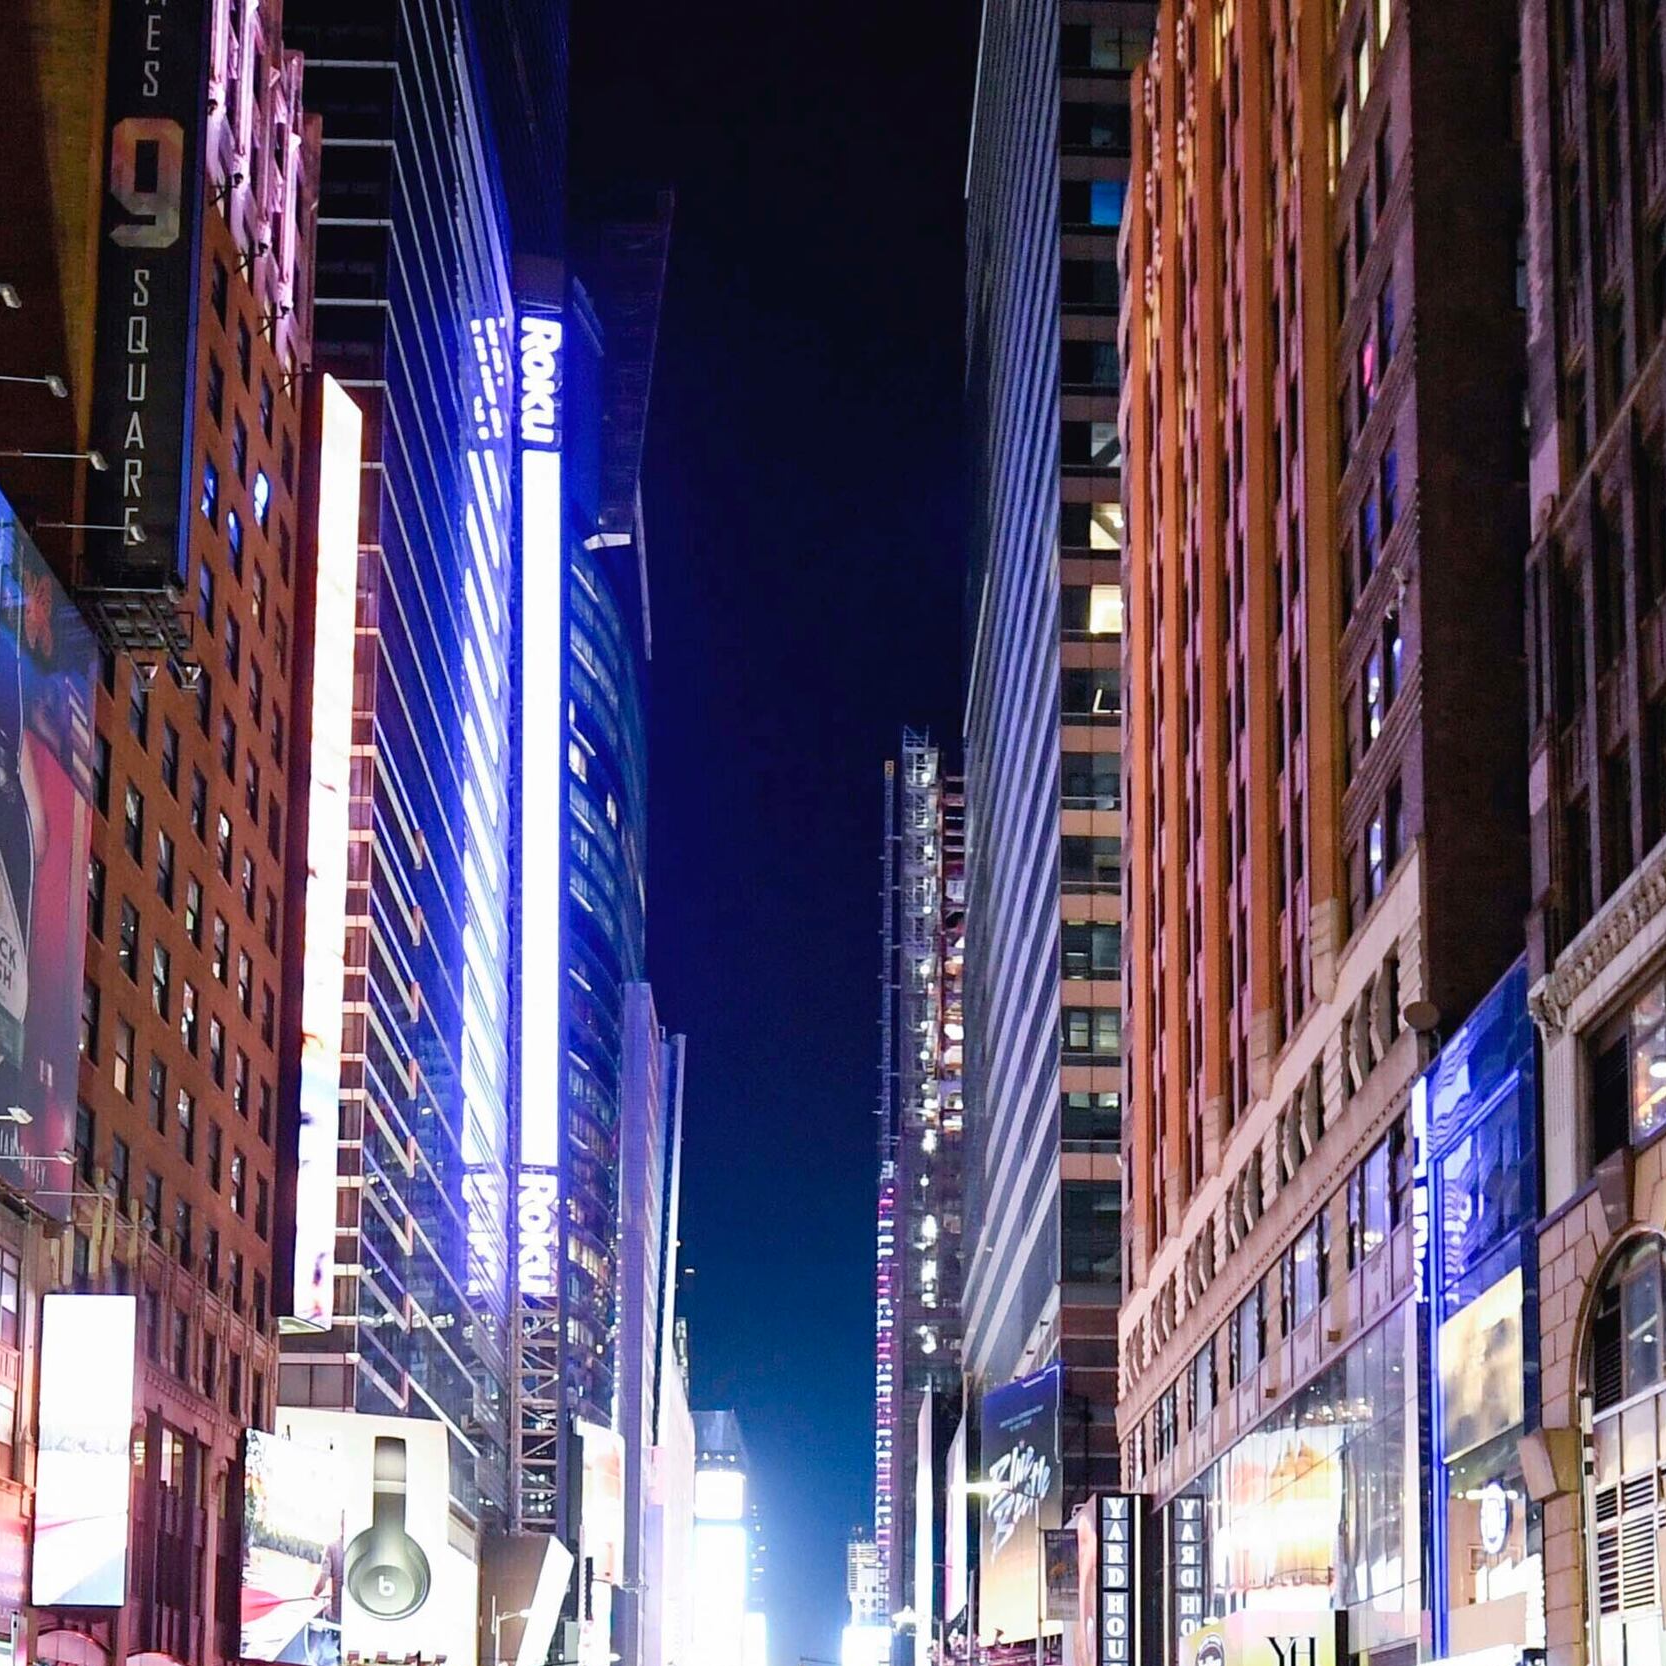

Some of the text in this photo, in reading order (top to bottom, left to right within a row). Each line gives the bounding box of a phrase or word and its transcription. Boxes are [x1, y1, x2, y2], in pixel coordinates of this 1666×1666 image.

[143, 0, 167, 97] ES
[109, 117, 186, 248] 9
[123, 269, 150, 547] SQUARE
[1107, 1497, 1126, 1586] YARD
